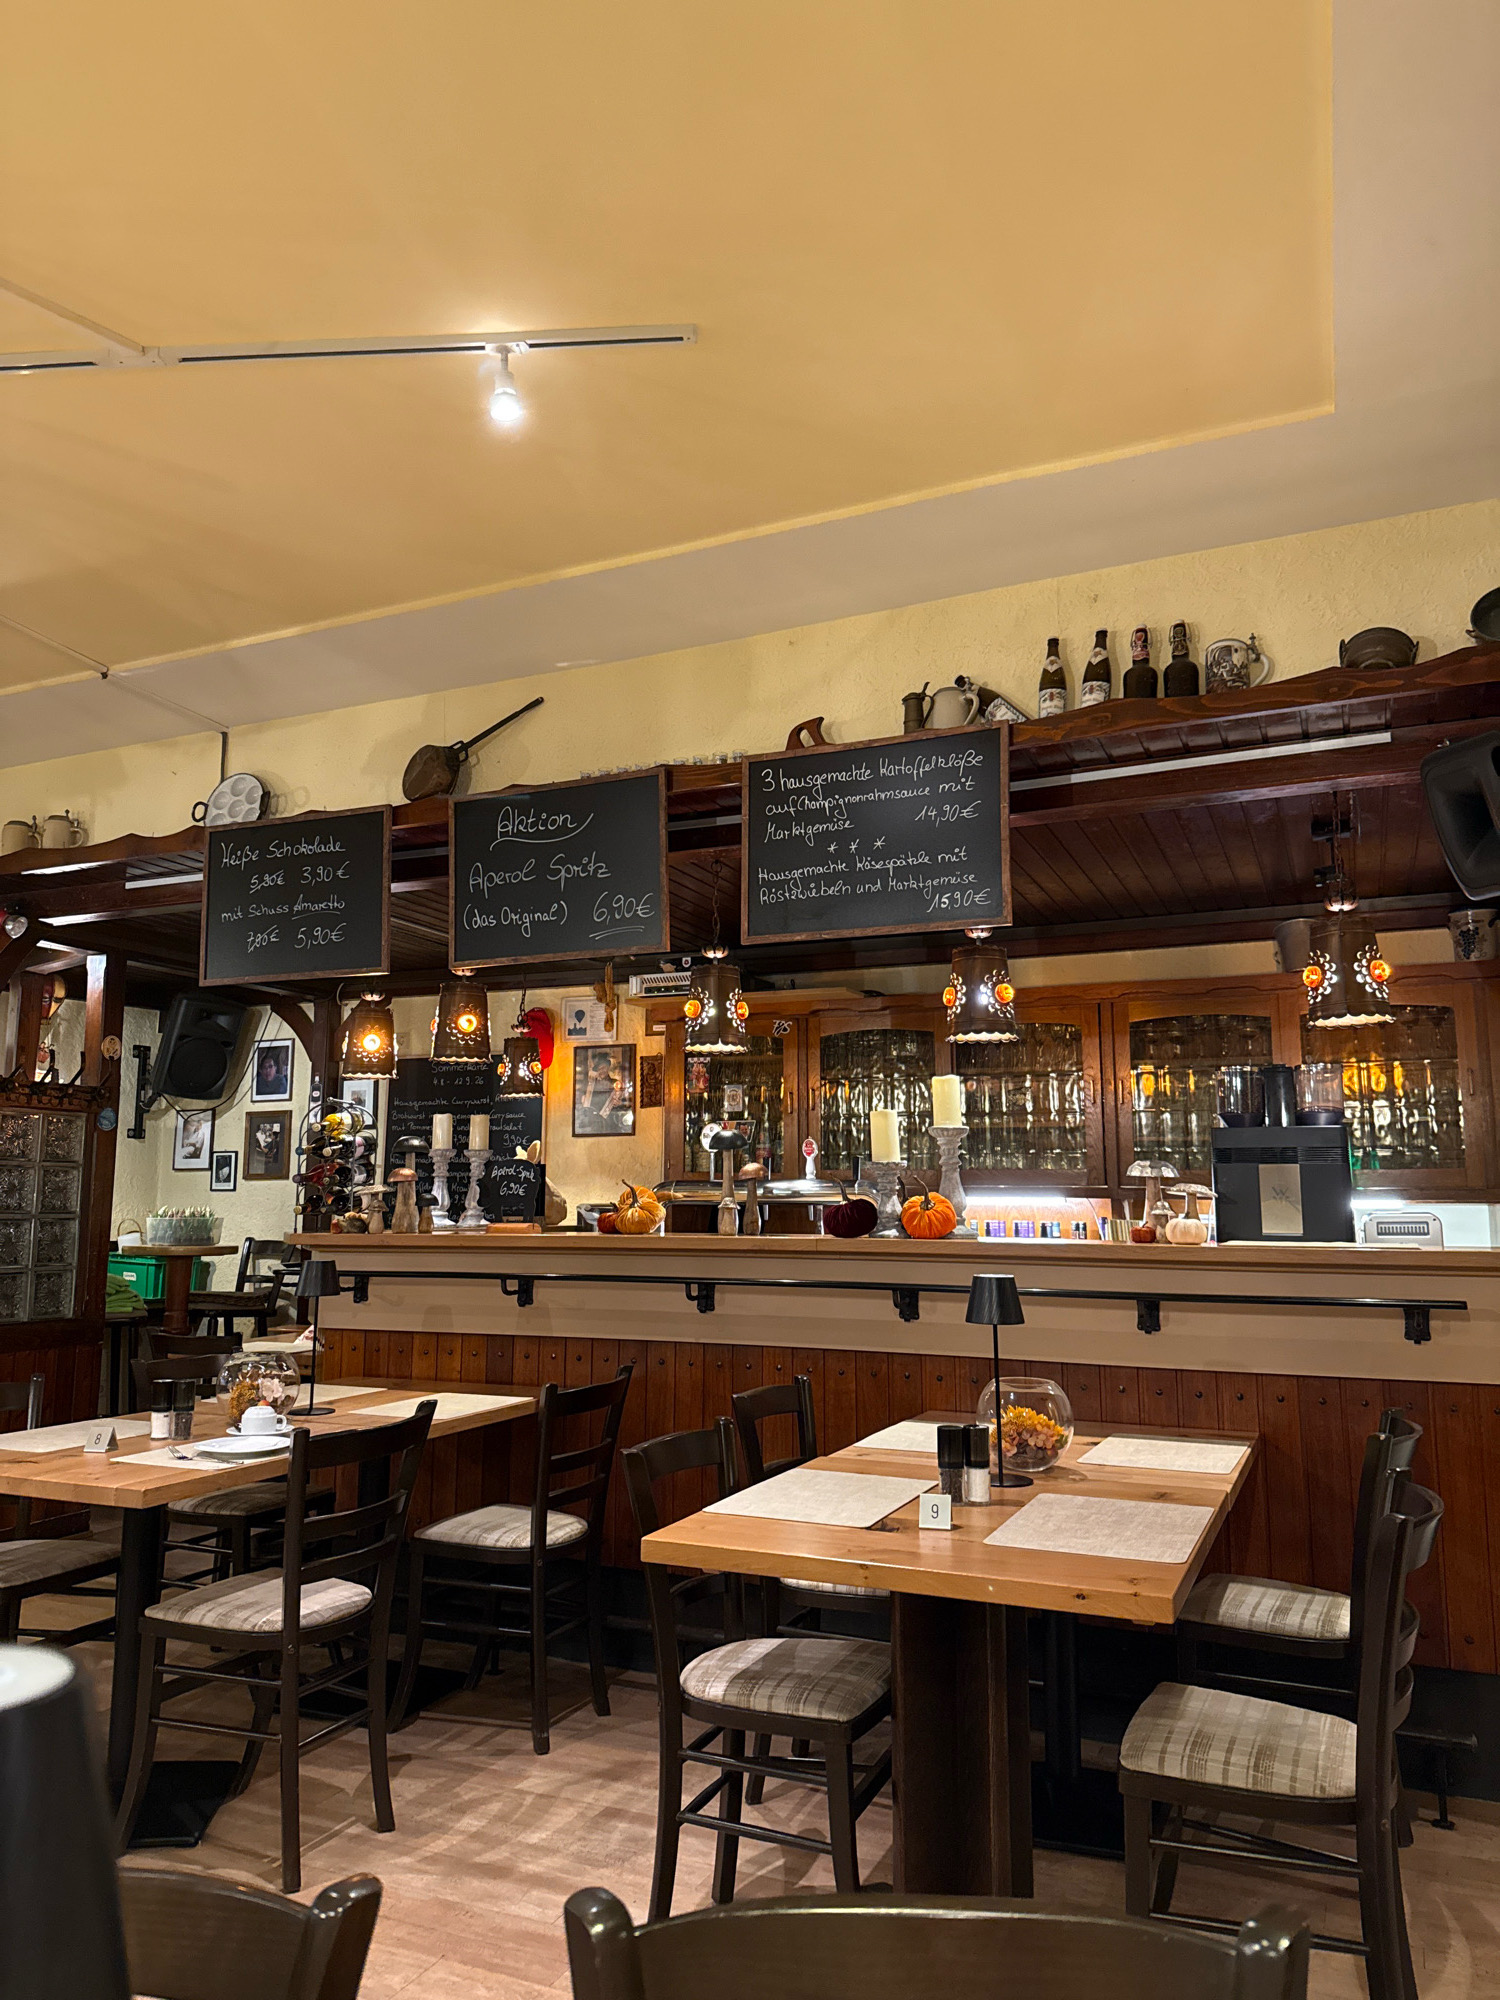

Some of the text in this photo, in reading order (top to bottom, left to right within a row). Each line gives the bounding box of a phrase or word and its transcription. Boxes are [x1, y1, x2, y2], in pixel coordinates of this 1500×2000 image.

[761, 749, 984, 800] 3 hausgemachte Kartoffelklöße
[938, 776, 976, 794] mit
[496, 805, 578, 840] Aktion
[764, 800, 982, 847] Marktgemüse 14,90€
[220, 835, 347, 871] Heiße Schokolade
[758, 845, 968, 889] Hausgemachte Käsespätzle mit
[469, 851, 612, 900] Aperol Spritz
[759, 871, 979, 905] Röstzwiebeln und Marktgemüse
[221, 893, 346, 923] mit Schuss Amaretto
[463, 891, 655, 938] (das Original) 6,90€
[926, 888, 992, 913] 15,90€
[294, 922, 348, 950] 5,90€
[499, 1180, 528, 1197] 6,90€
[94, 1433, 102, 1445] 8
[931, 1503, 939, 1519] 9
